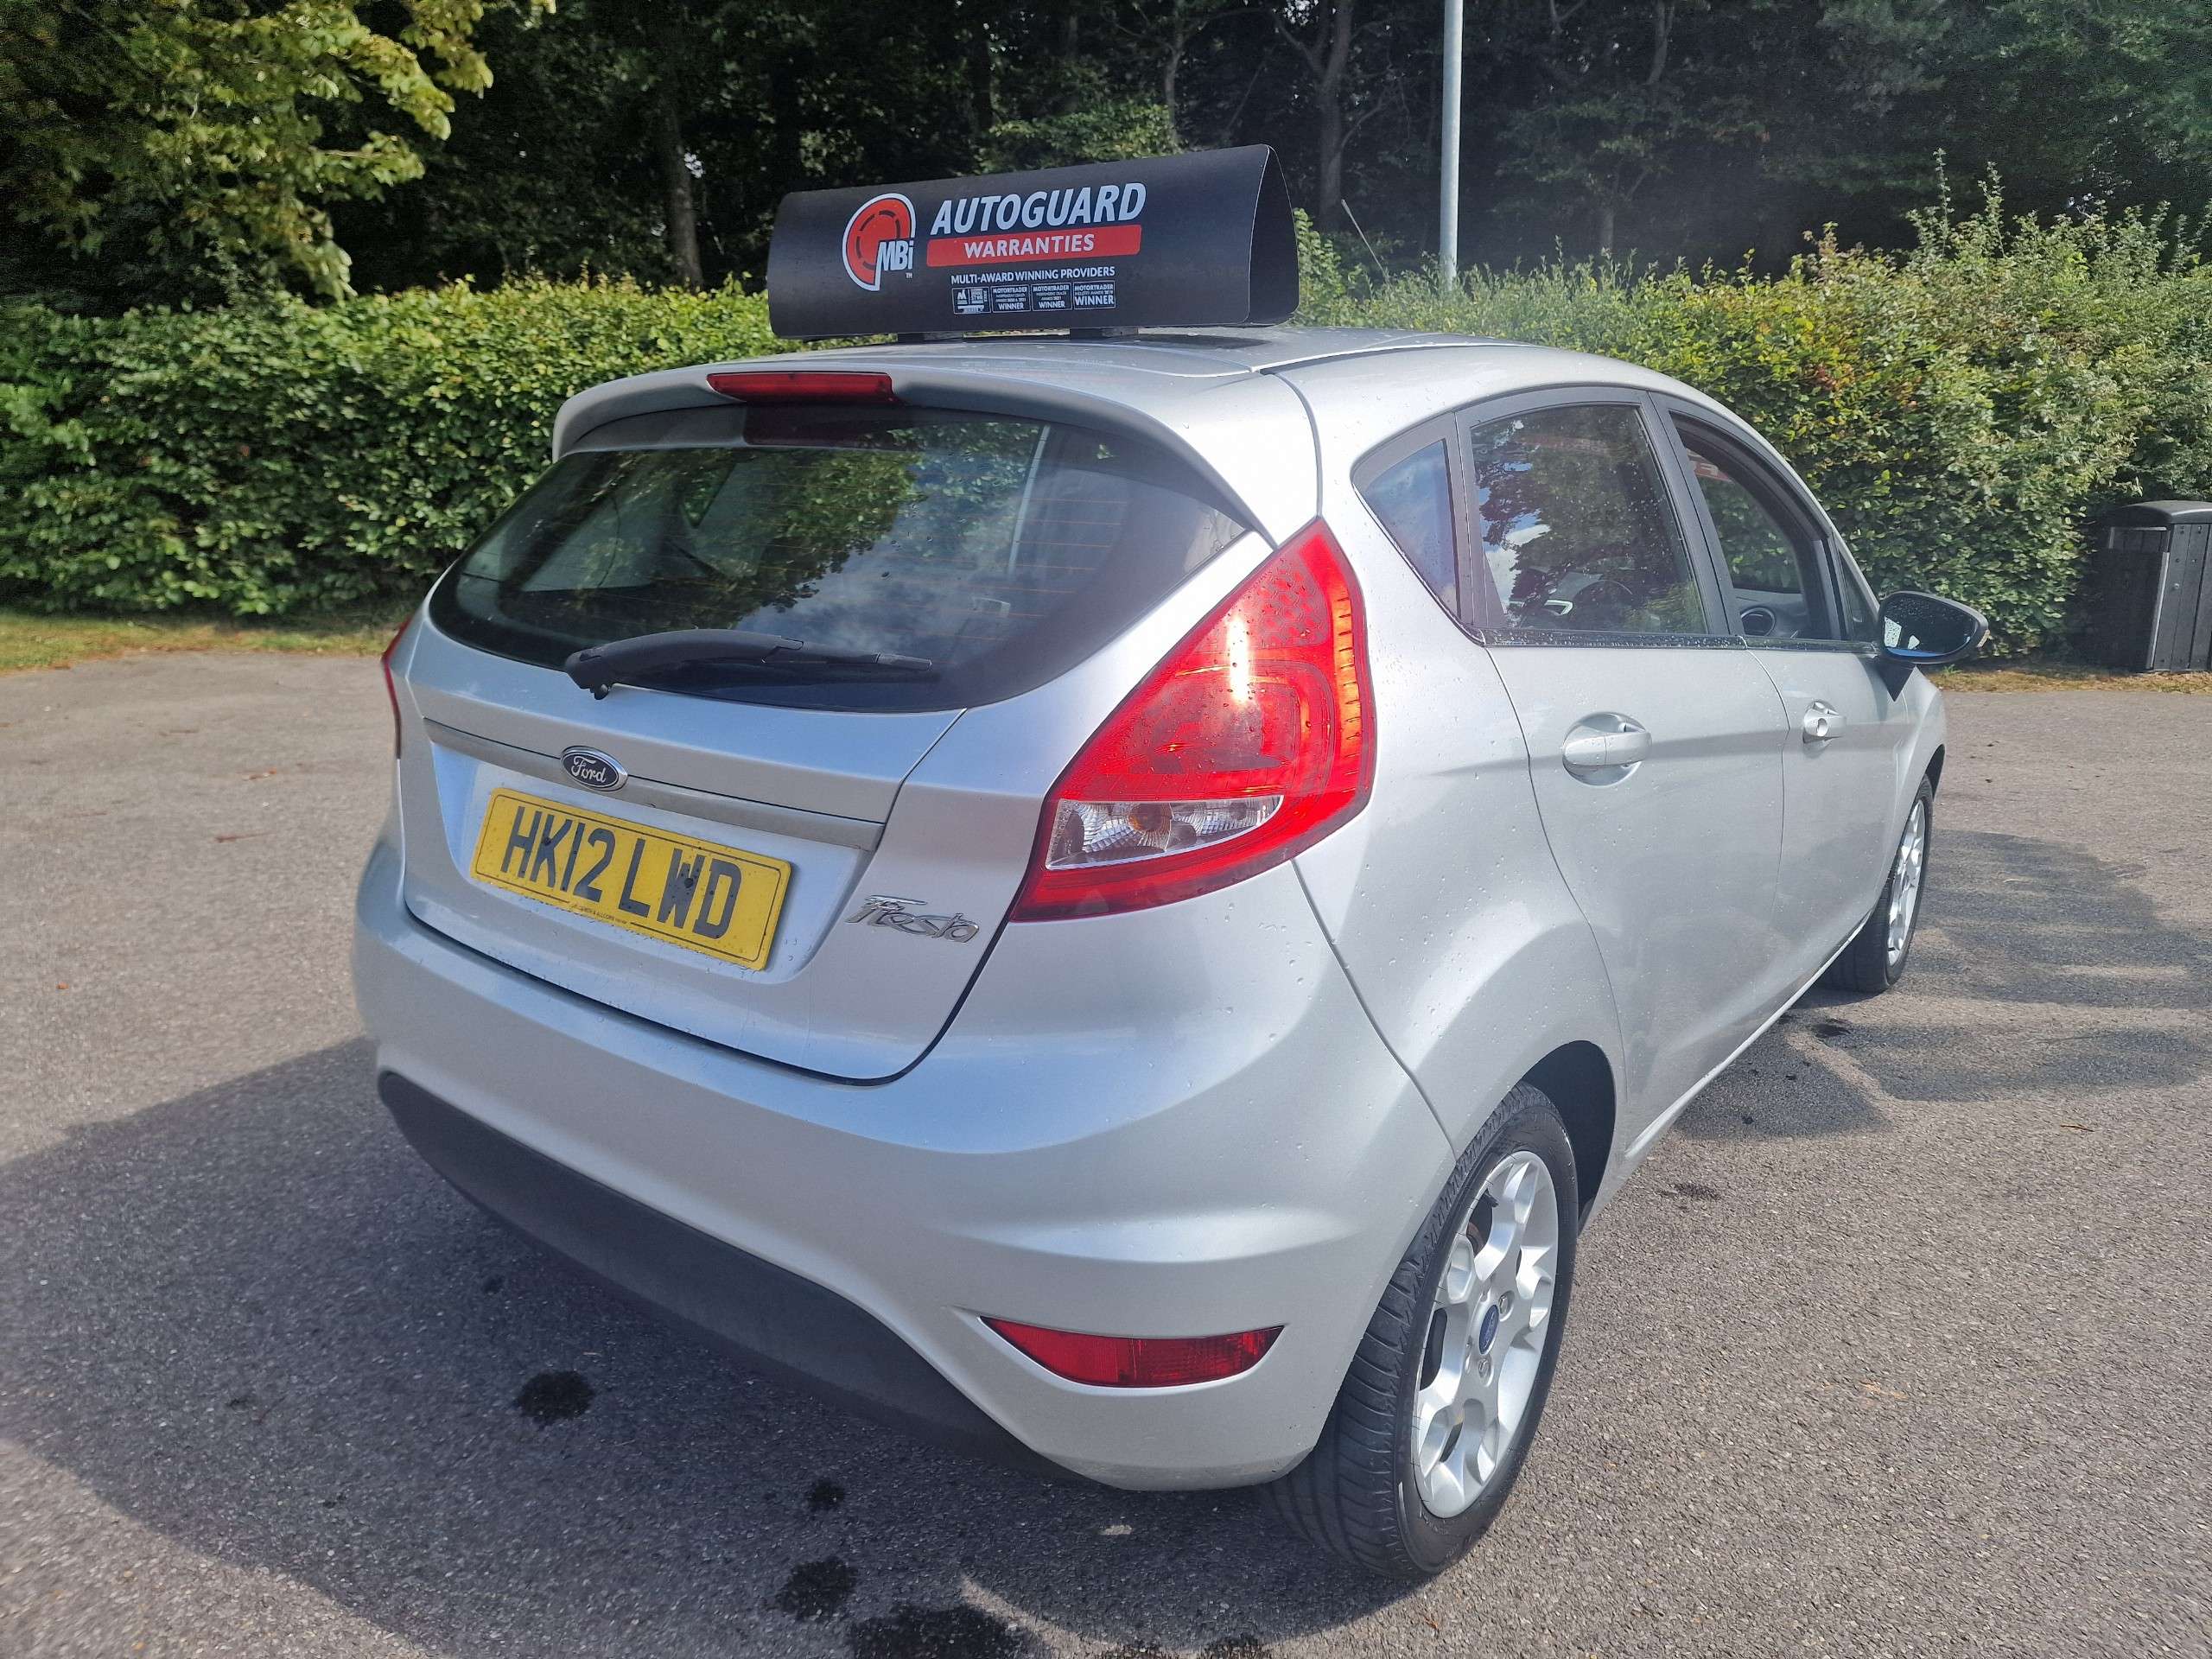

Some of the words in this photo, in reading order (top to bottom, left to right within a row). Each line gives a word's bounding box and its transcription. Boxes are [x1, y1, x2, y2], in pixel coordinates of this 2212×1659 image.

[930, 182, 1147, 236] AUTOGUARD
[964, 233, 1095, 258] WARRANTIES
[951, 272, 1014, 285] MULTI-AWARD
[1014, 269, 1059, 282] WINNING
[1060, 266, 1116, 279] PROVIDERS
[998, 302, 1025, 310] WINNER
[1074, 295, 1115, 306] WINNER
[571, 755, 607, 783] Ford
[501, 805, 616, 903] HK12
[618, 838, 742, 940] LWD
[844, 895, 980, 944] Fiesta
